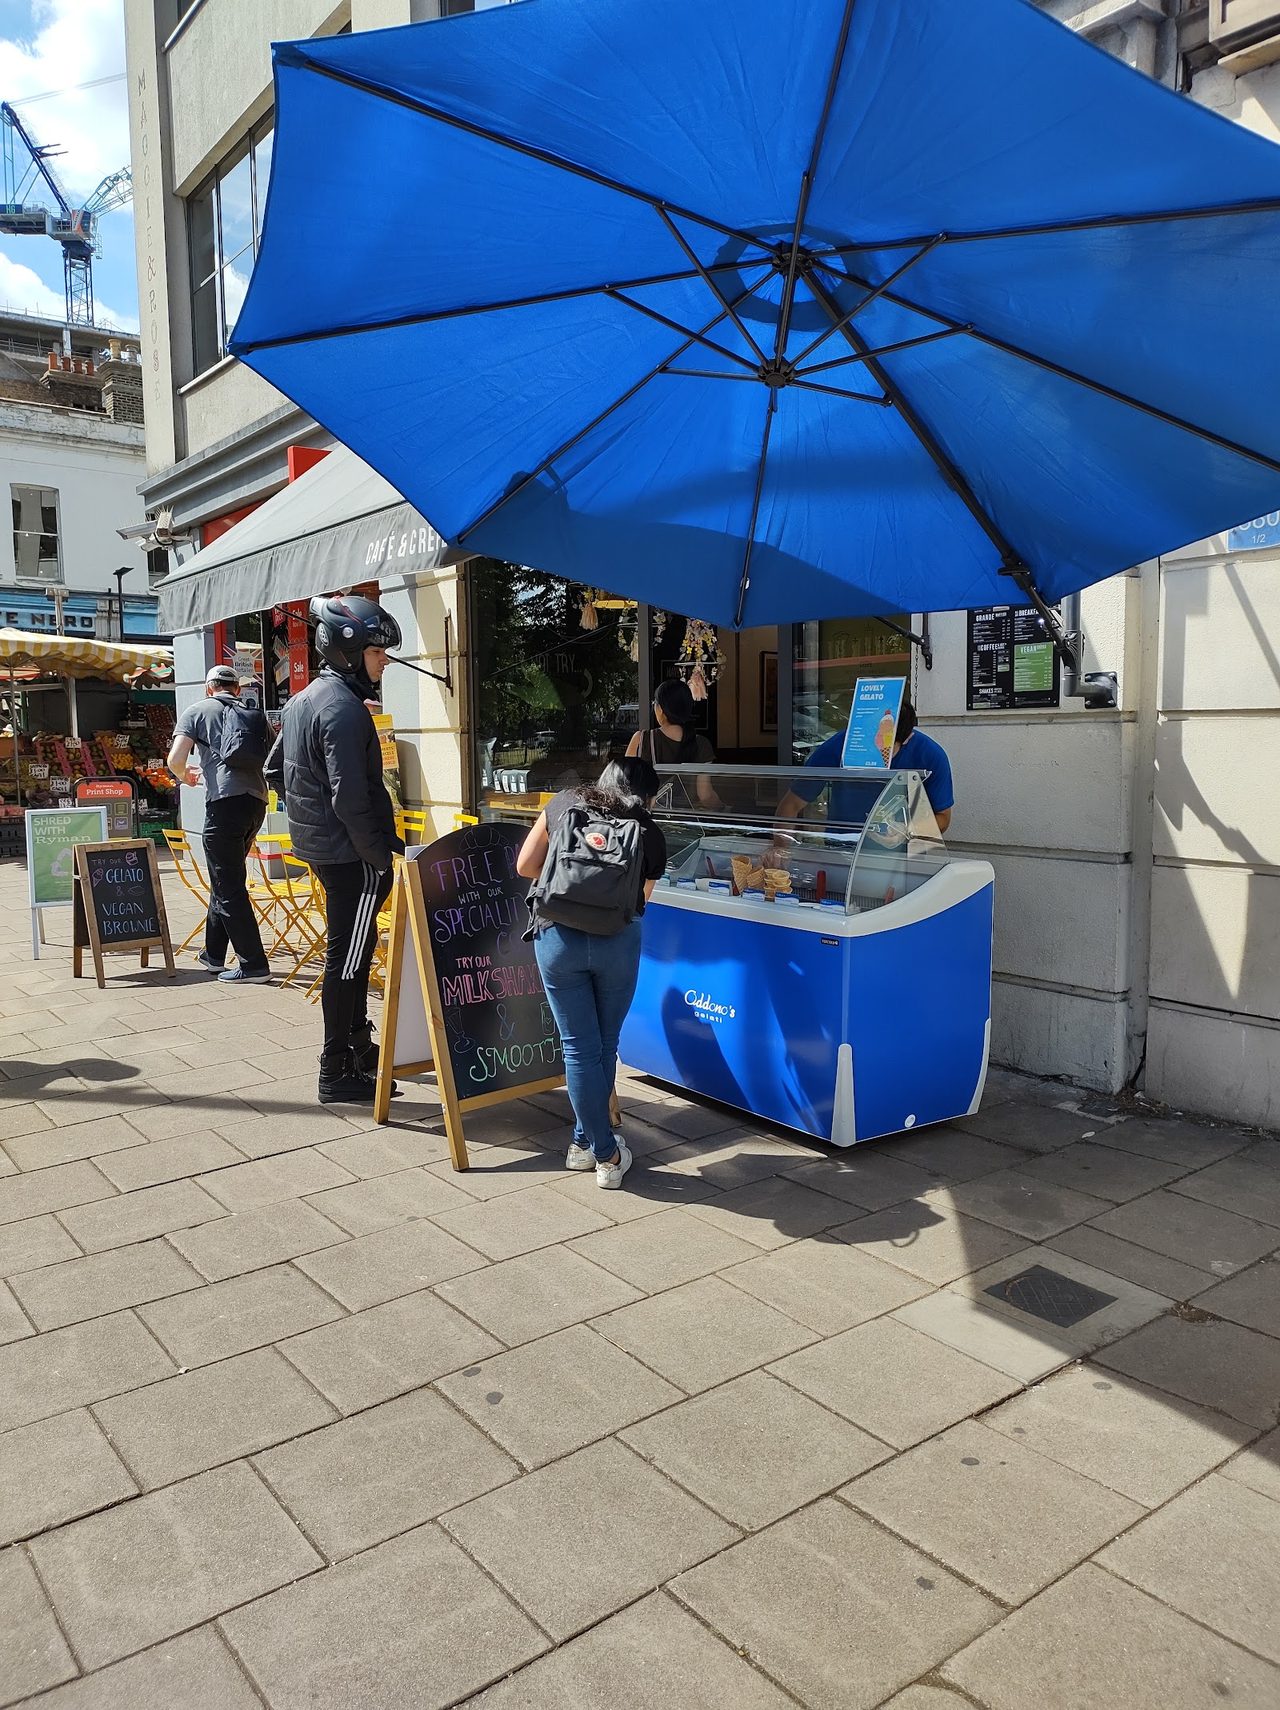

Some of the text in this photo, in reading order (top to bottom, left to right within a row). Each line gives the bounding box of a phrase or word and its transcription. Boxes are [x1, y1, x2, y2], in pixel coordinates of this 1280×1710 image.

[1252, 533, 1266, 544] 1/2
[365, 530, 396, 566] CAFÉ
[397, 532, 408, 558] &
[31, 613, 93, 628] NERO
[293, 661, 304, 673] Sale
[861, 684, 885, 692] LOVELY
[859, 693, 884, 701] GELATO
[86, 788, 124, 796] Print Shop
[33, 816, 72, 827] SHRED
[33, 826, 66, 836] WITH
[35, 834, 92, 845] Ryman
[105, 868, 144, 884] GELATO
[430, 850, 503, 891] FREE
[457, 886, 504, 905] WITH OUR
[102, 902, 144, 916] VEGAN
[455, 956, 492, 969] TRY OUR
[496, 1003, 515, 1041] &
